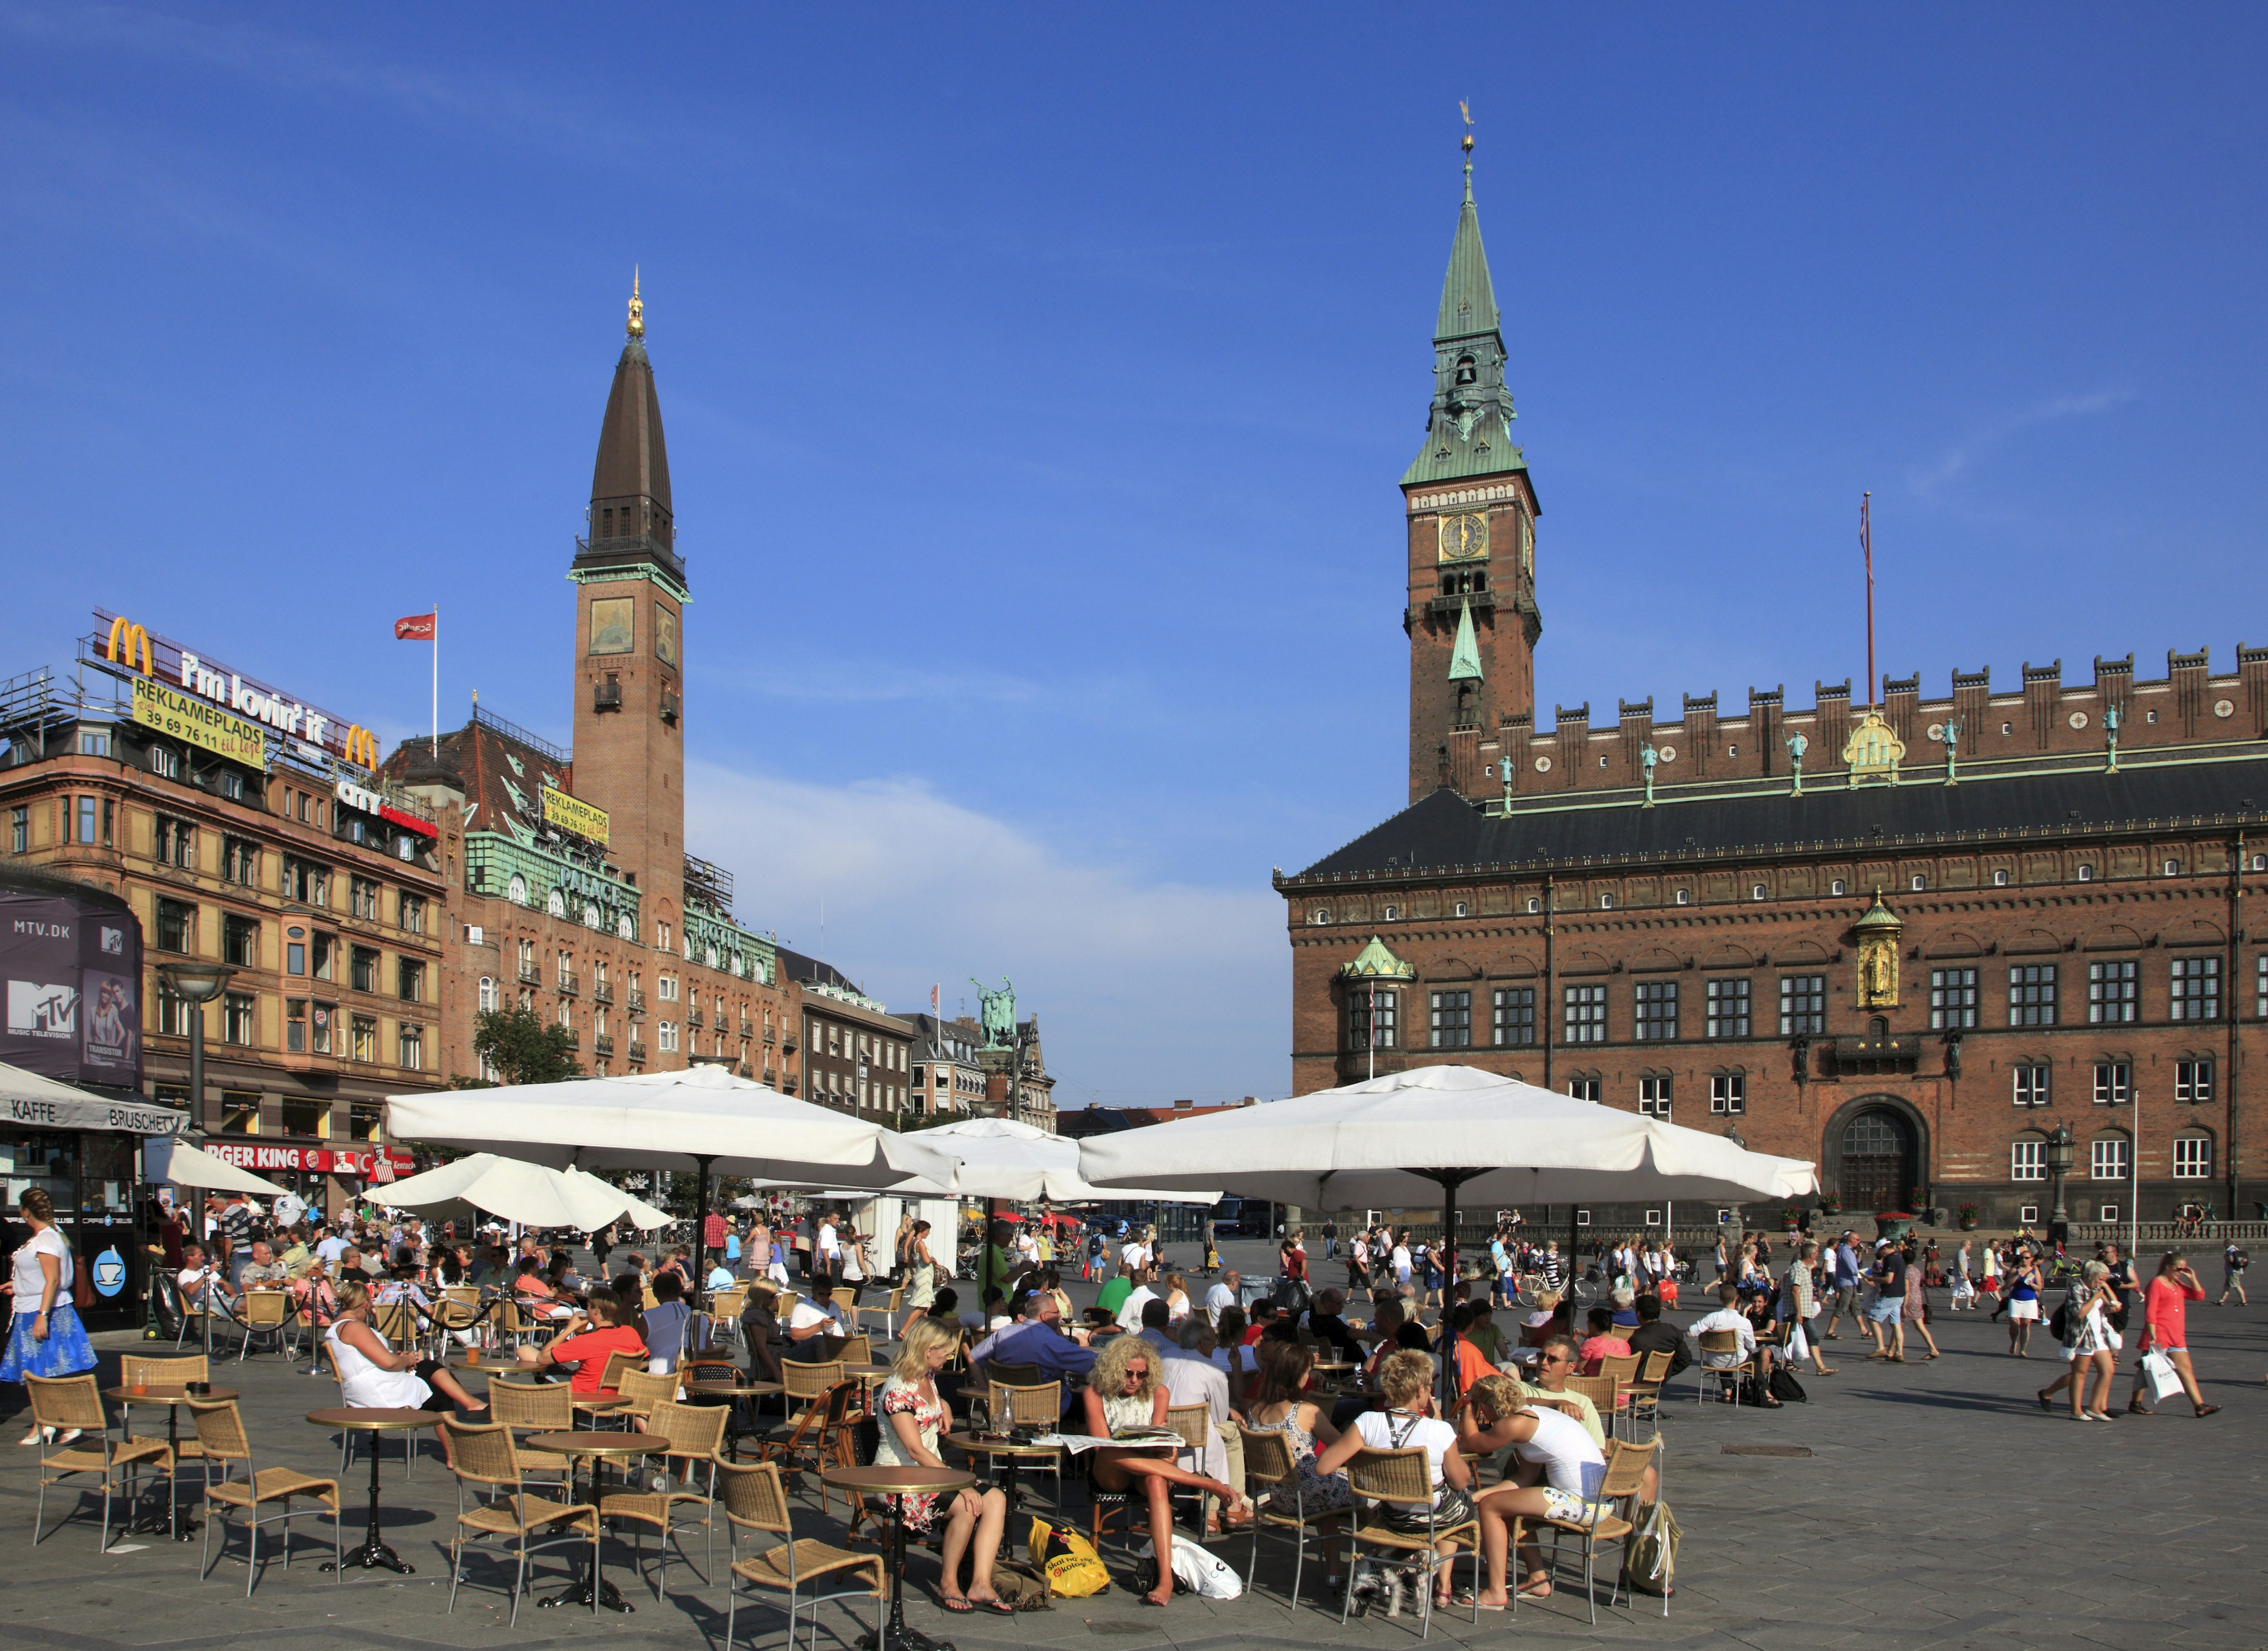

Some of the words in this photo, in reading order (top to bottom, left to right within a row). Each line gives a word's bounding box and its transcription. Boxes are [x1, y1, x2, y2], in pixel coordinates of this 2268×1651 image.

[136, 679, 260, 745] REKLAMEPLADS
[182, 651, 225, 703] i'm
[232, 674, 302, 734] lovin'
[306, 709, 327, 746] it
[147, 709, 162, 726] 39
[167, 719, 181, 733] 69
[185, 725, 200, 741] 76
[204, 733, 217, 749] 11
[221, 738, 236, 752] til
[239, 738, 260, 761] leje
[338, 781, 382, 815] CITY
[546, 791, 607, 827] REKLAMEPLADS
[552, 811, 559, 821] 39
[561, 817, 569, 825] 69
[571, 819, 577, 828] 76
[579, 823, 586, 833] 11
[561, 866, 620, 907] PALACE
[14, 920, 70, 939] MTV.DK
[101, 925, 125, 952] MTV
[698, 918, 742, 951] HOTEL
[8, 980, 82, 1033] MTV
[32, 1030, 71, 1039] TELEVISION
[88, 1044, 122, 1057] TRANSISTOR
[11, 1099, 56, 1123] KAFFE
[257, 1148, 299, 1169] KING
[310, 1174, 318, 1183] 55
[1047, 1559, 1065, 1571] skal
